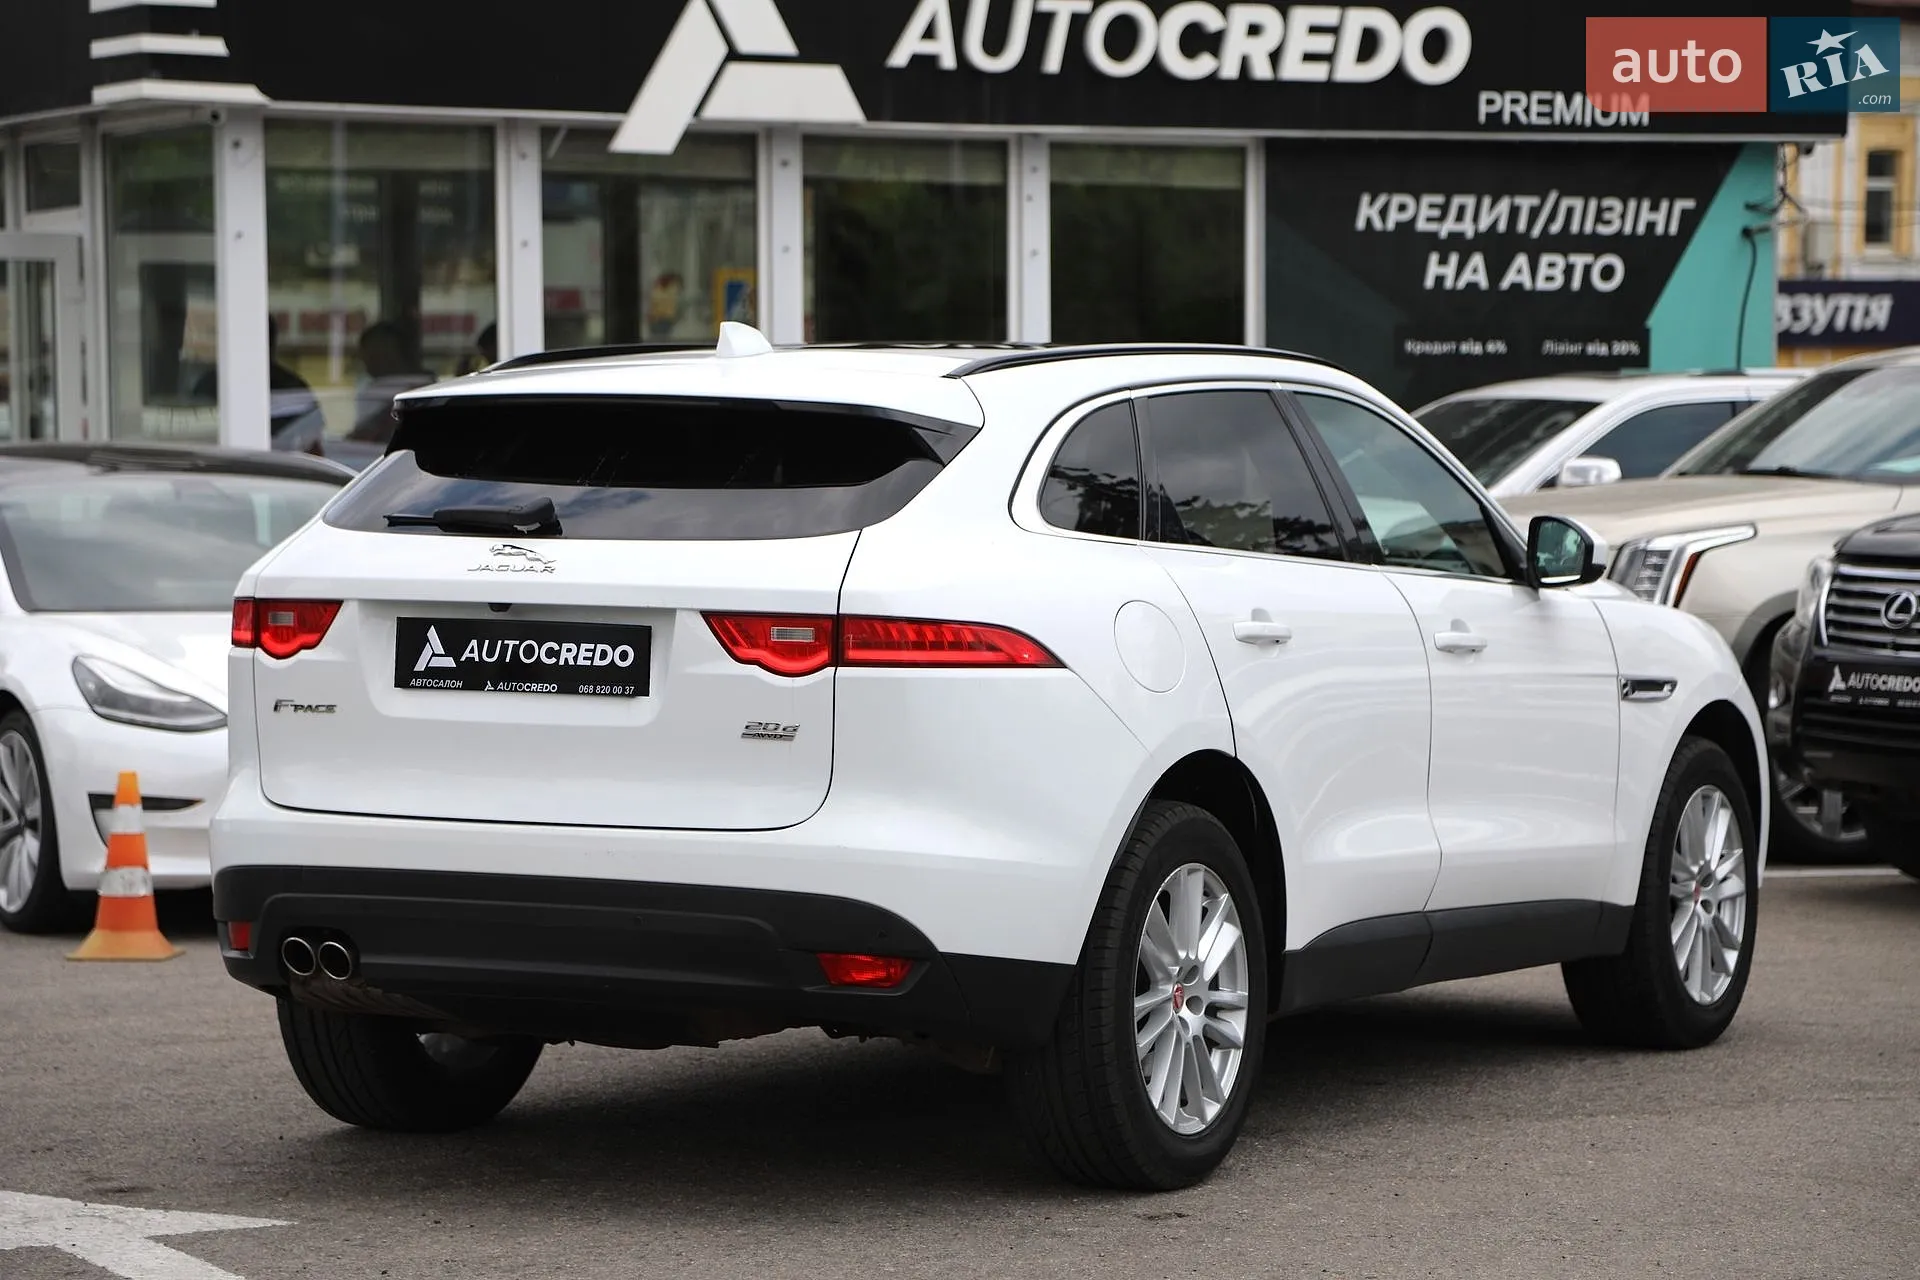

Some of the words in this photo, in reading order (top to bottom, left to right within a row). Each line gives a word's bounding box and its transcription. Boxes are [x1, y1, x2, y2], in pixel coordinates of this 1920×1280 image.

[885, 0, 1473, 86] AUTOCREDO
[1477, 90, 1650, 128] PREMIUM
[1355, 189, 1697, 239] КРЕДИТ/ЛІЗІНГ
[1423, 251, 1490, 291] НА
[1499, 252, 1626, 292] АВТО
[466, 564, 556, 574] JAGUAR
[459, 639, 635, 668] AUTOCREDO
[409, 678, 463, 689] АВТОСАЛОН
[496, 681, 558, 693] AUTOCREDO
[578, 684, 594, 694] 068
[595, 685, 611, 694] 820
[612, 686, 623, 694] 00
[624, 686, 635, 695] 37
[1847, 672, 1920, 694] AUTOCREDO
